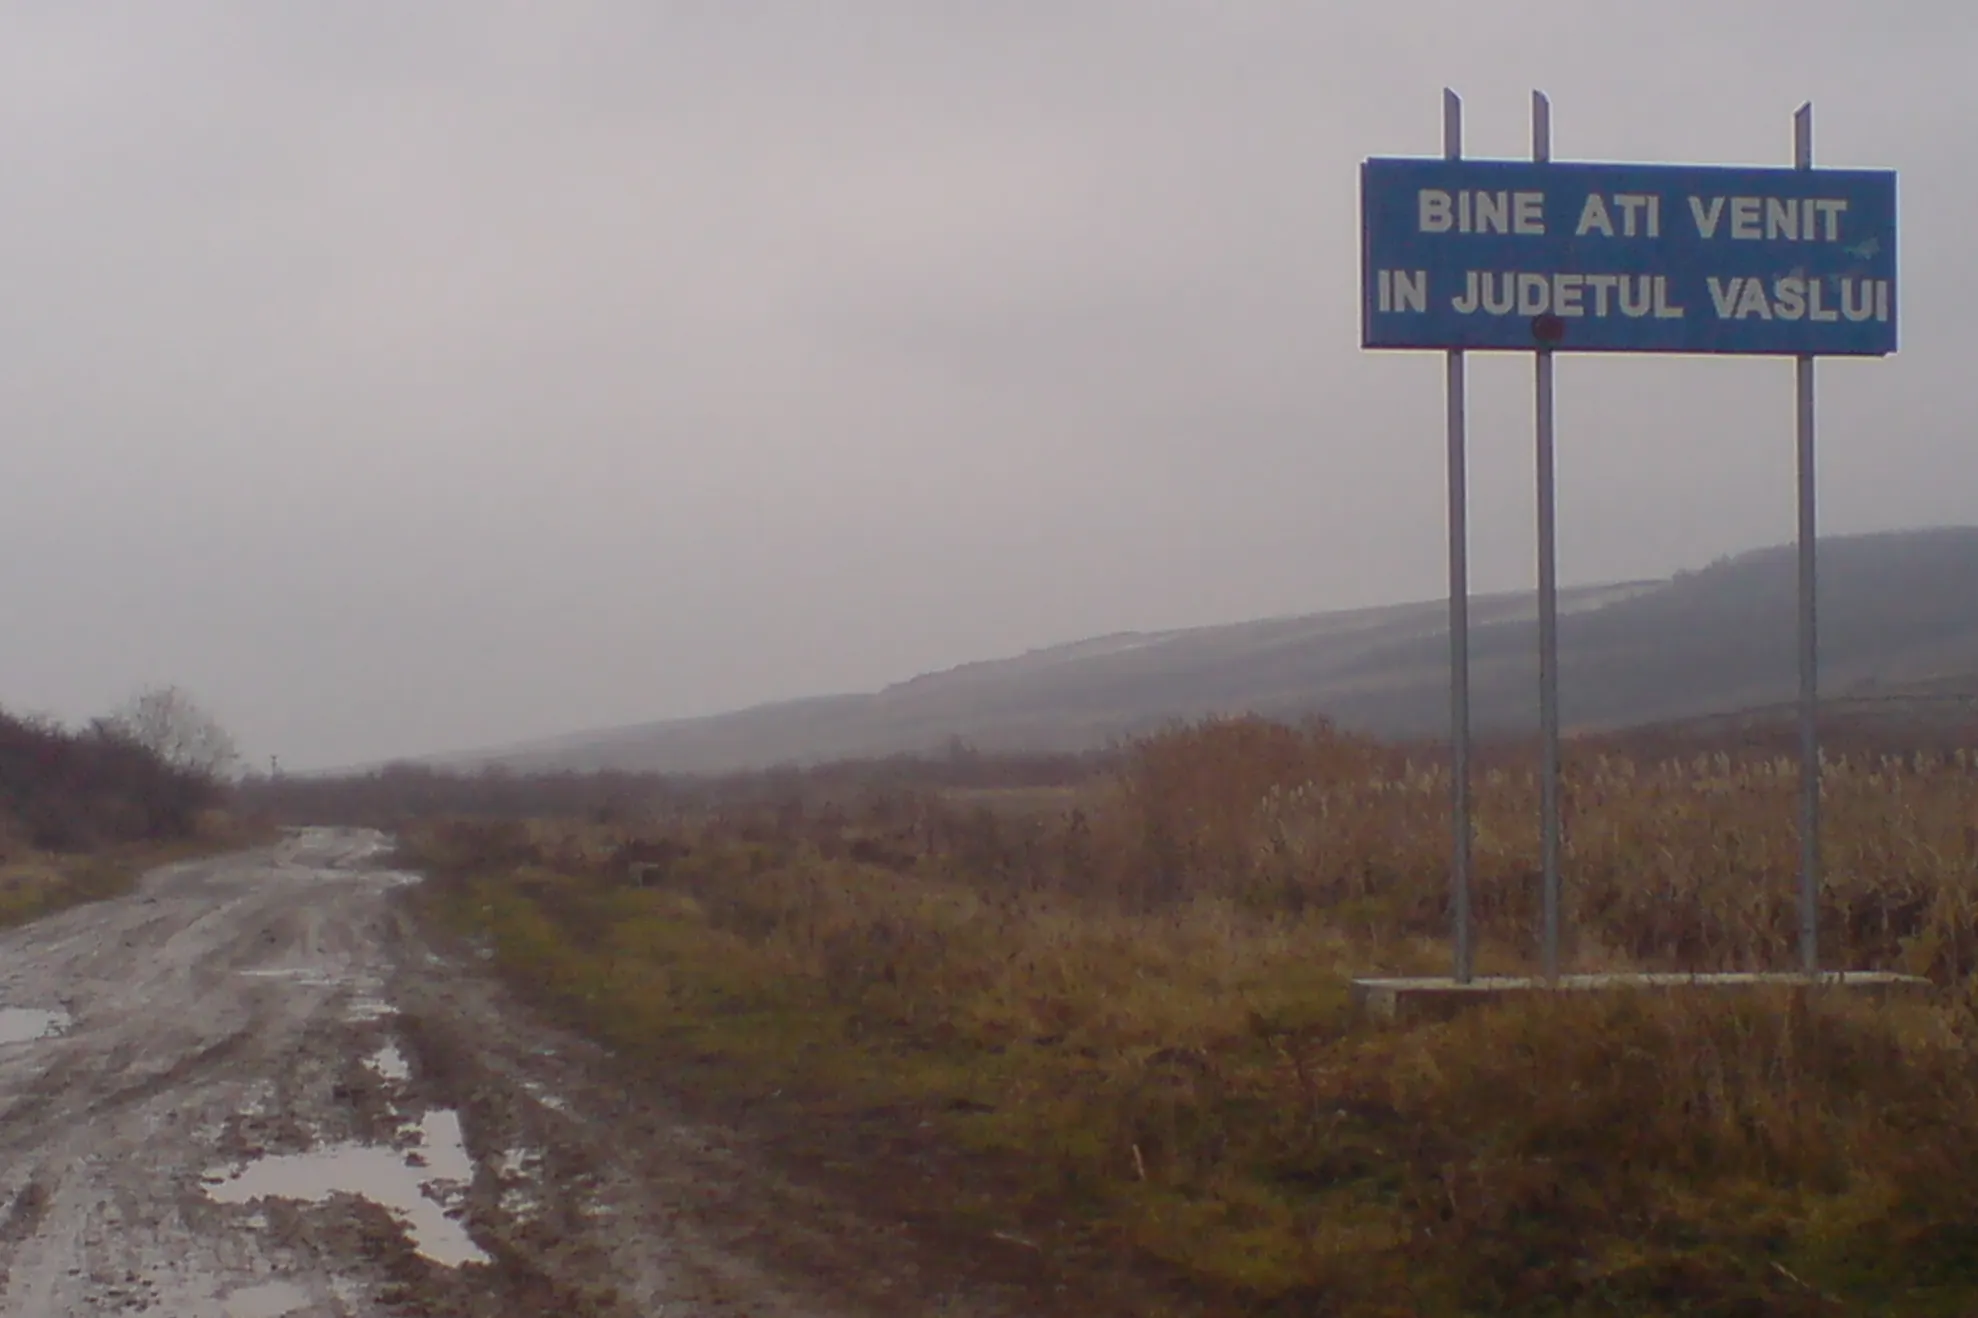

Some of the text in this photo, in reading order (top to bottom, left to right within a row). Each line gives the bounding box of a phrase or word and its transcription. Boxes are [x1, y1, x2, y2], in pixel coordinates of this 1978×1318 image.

[1418, 189, 1847, 241] BINE ATI VENIT
[1378, 270, 1888, 322] IN JUDETUL VASLUI
